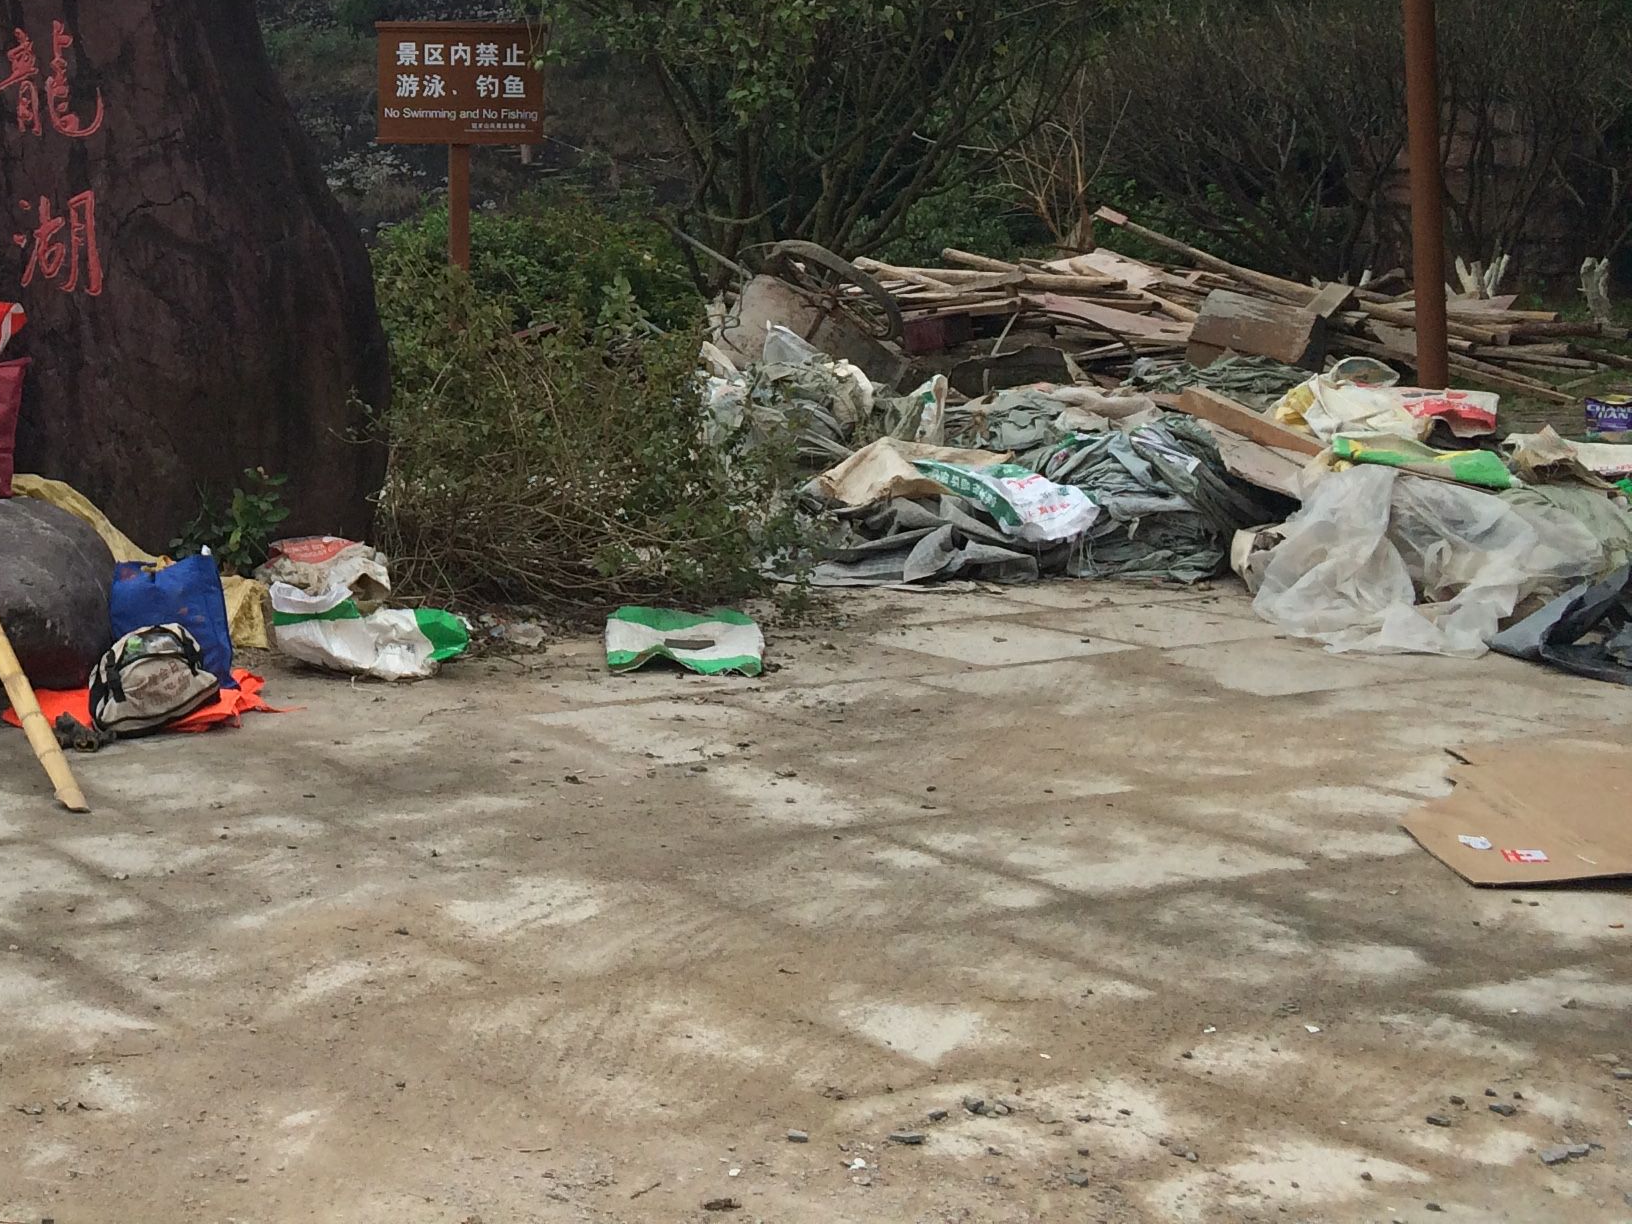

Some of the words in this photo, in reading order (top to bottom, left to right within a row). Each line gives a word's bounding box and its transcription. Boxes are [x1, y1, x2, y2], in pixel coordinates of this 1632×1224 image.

[395, 41, 526, 67] 景区内禁止
[395, 73, 526, 98] 游泳、钓鱼
[384, 107, 400, 119] No
[402, 107, 457, 121] Swimming
[459, 108, 480, 119] and
[482, 108, 498, 120] No
[500, 108, 538, 122] Fishing
